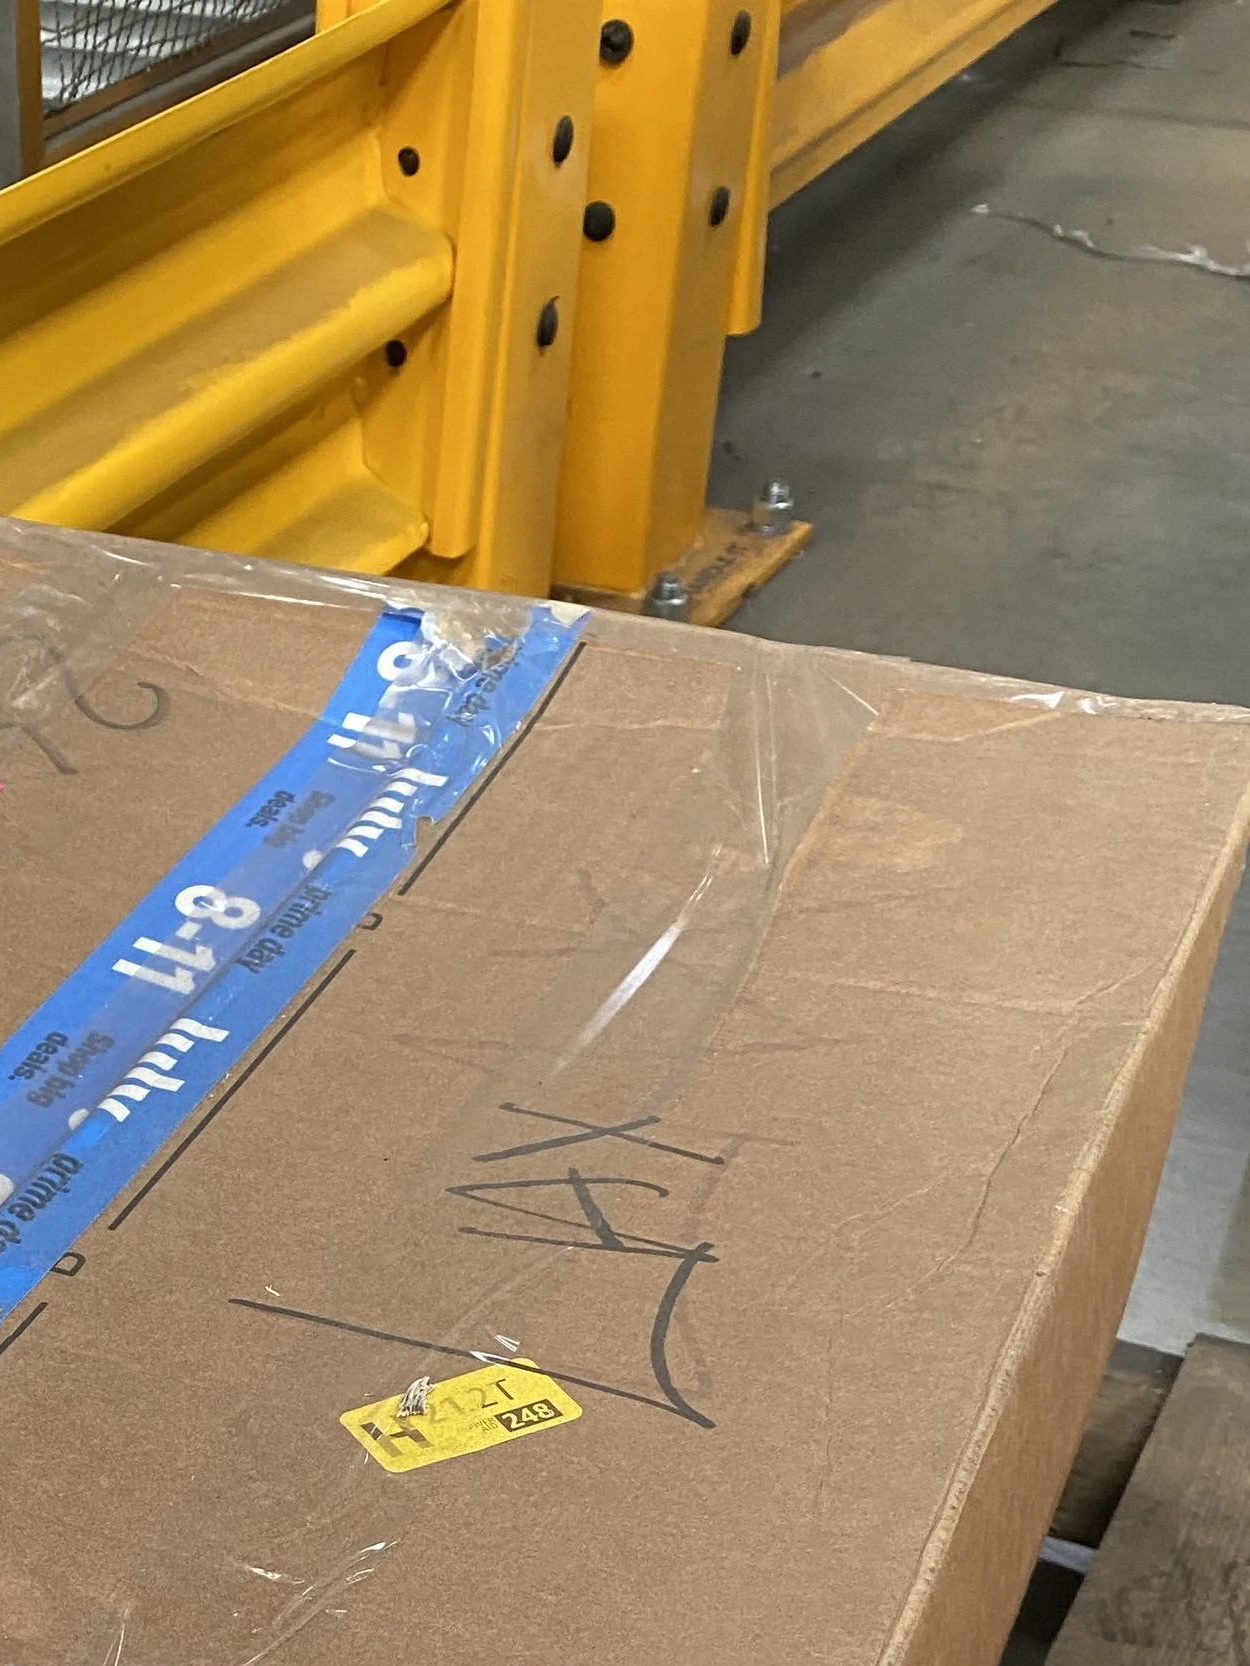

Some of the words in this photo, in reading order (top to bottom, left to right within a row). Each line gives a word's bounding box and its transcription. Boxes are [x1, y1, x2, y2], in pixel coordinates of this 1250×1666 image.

[269, 884, 332, 939] prime
[108, 884, 258, 995] 8-11
[233, 938, 285, 974] day
[501, 1402, 556, 1430] 248
